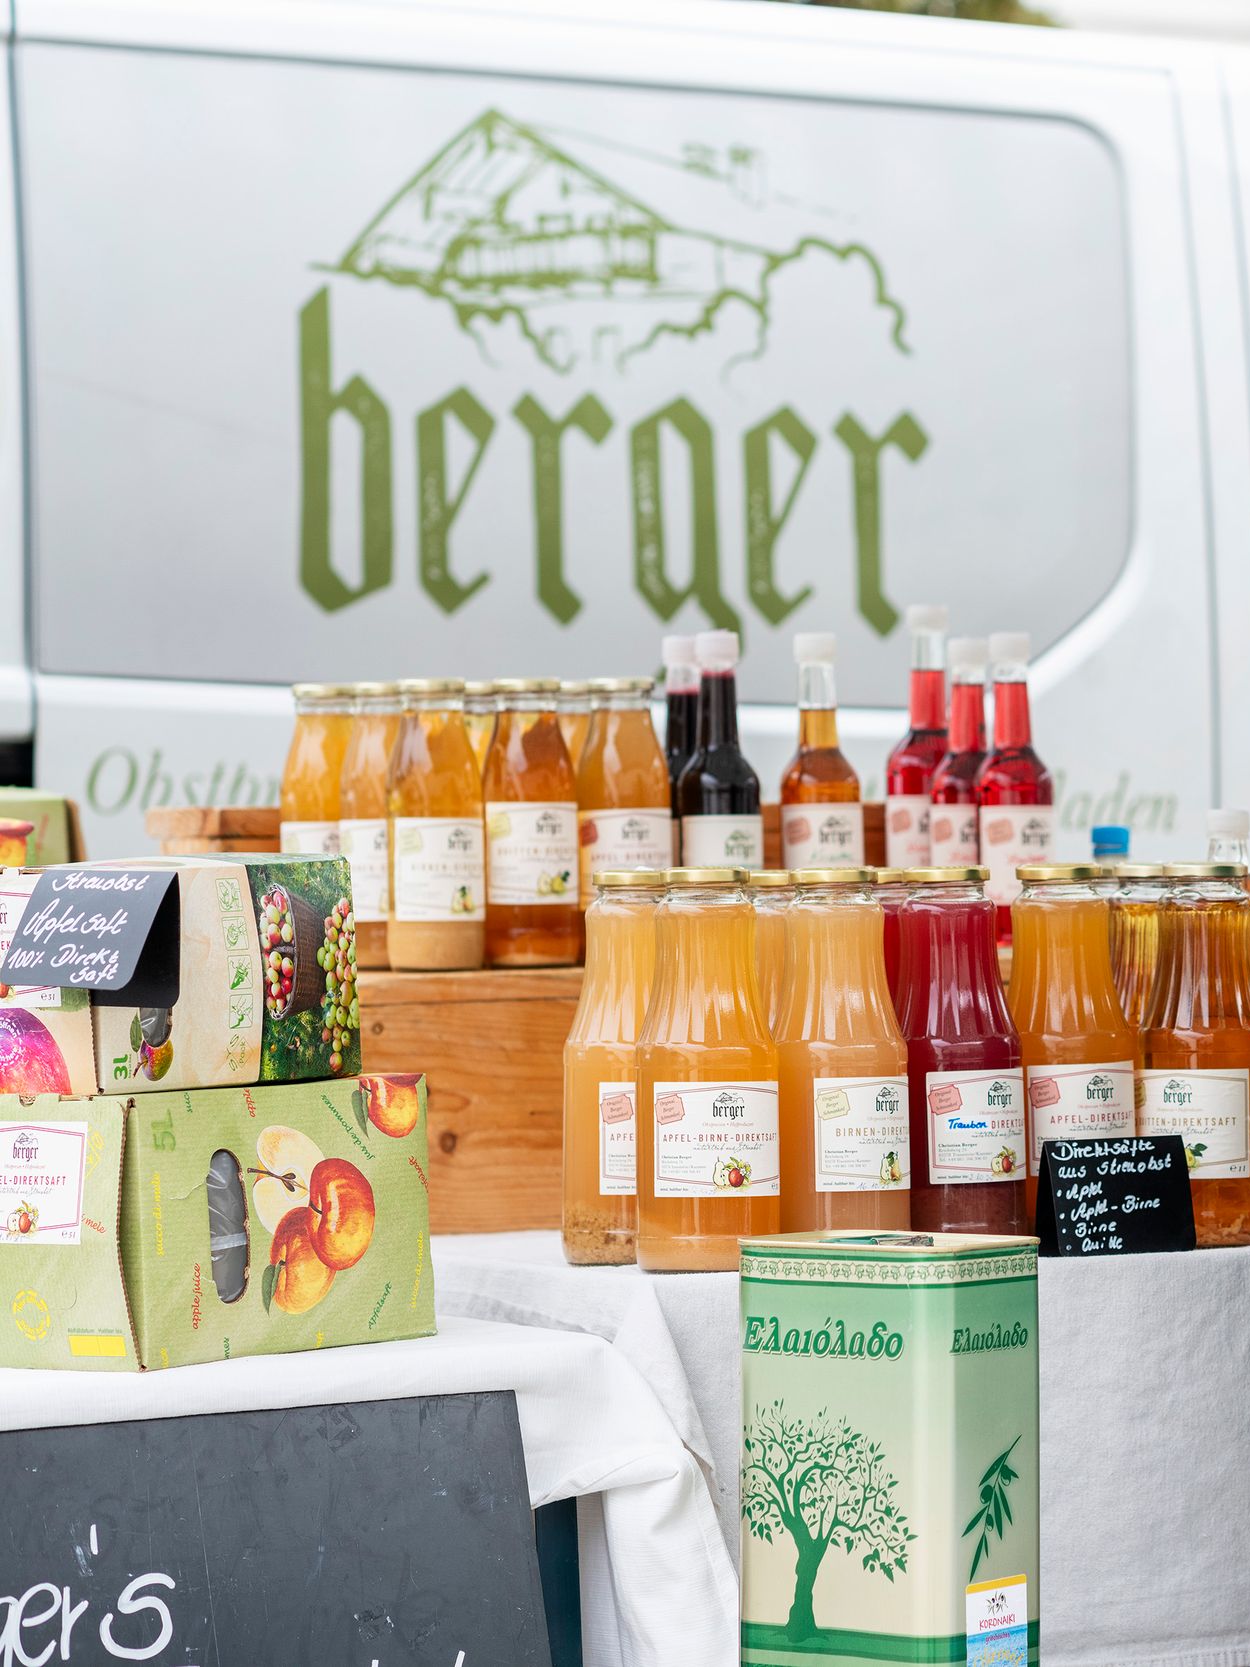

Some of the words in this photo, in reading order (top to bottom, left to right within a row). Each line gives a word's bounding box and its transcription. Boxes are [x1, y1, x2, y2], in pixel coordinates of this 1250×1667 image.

[298, 283, 931, 658] berger
[8, 948, 45, 969] 100%
[987, 1090, 1012, 1108] berger
[1086, 1084, 1114, 1101] berger
[1163, 1089, 1192, 1106] berger
[712, 1102, 745, 1120] berger
[875, 1097, 900, 1114] berger
[13, 1143, 38, 1162] berger
[1051, 1139, 1155, 1161] Direktsäfte
[1058, 1165, 1086, 1178] aus
[1075, 1221, 1117, 1238] Birne
[191, 1296, 202, 1330] apple
[743, 1316, 904, 1361] Ελαιόλαδο
[949, 1321, 1029, 1356] Ελαιόλαδο
